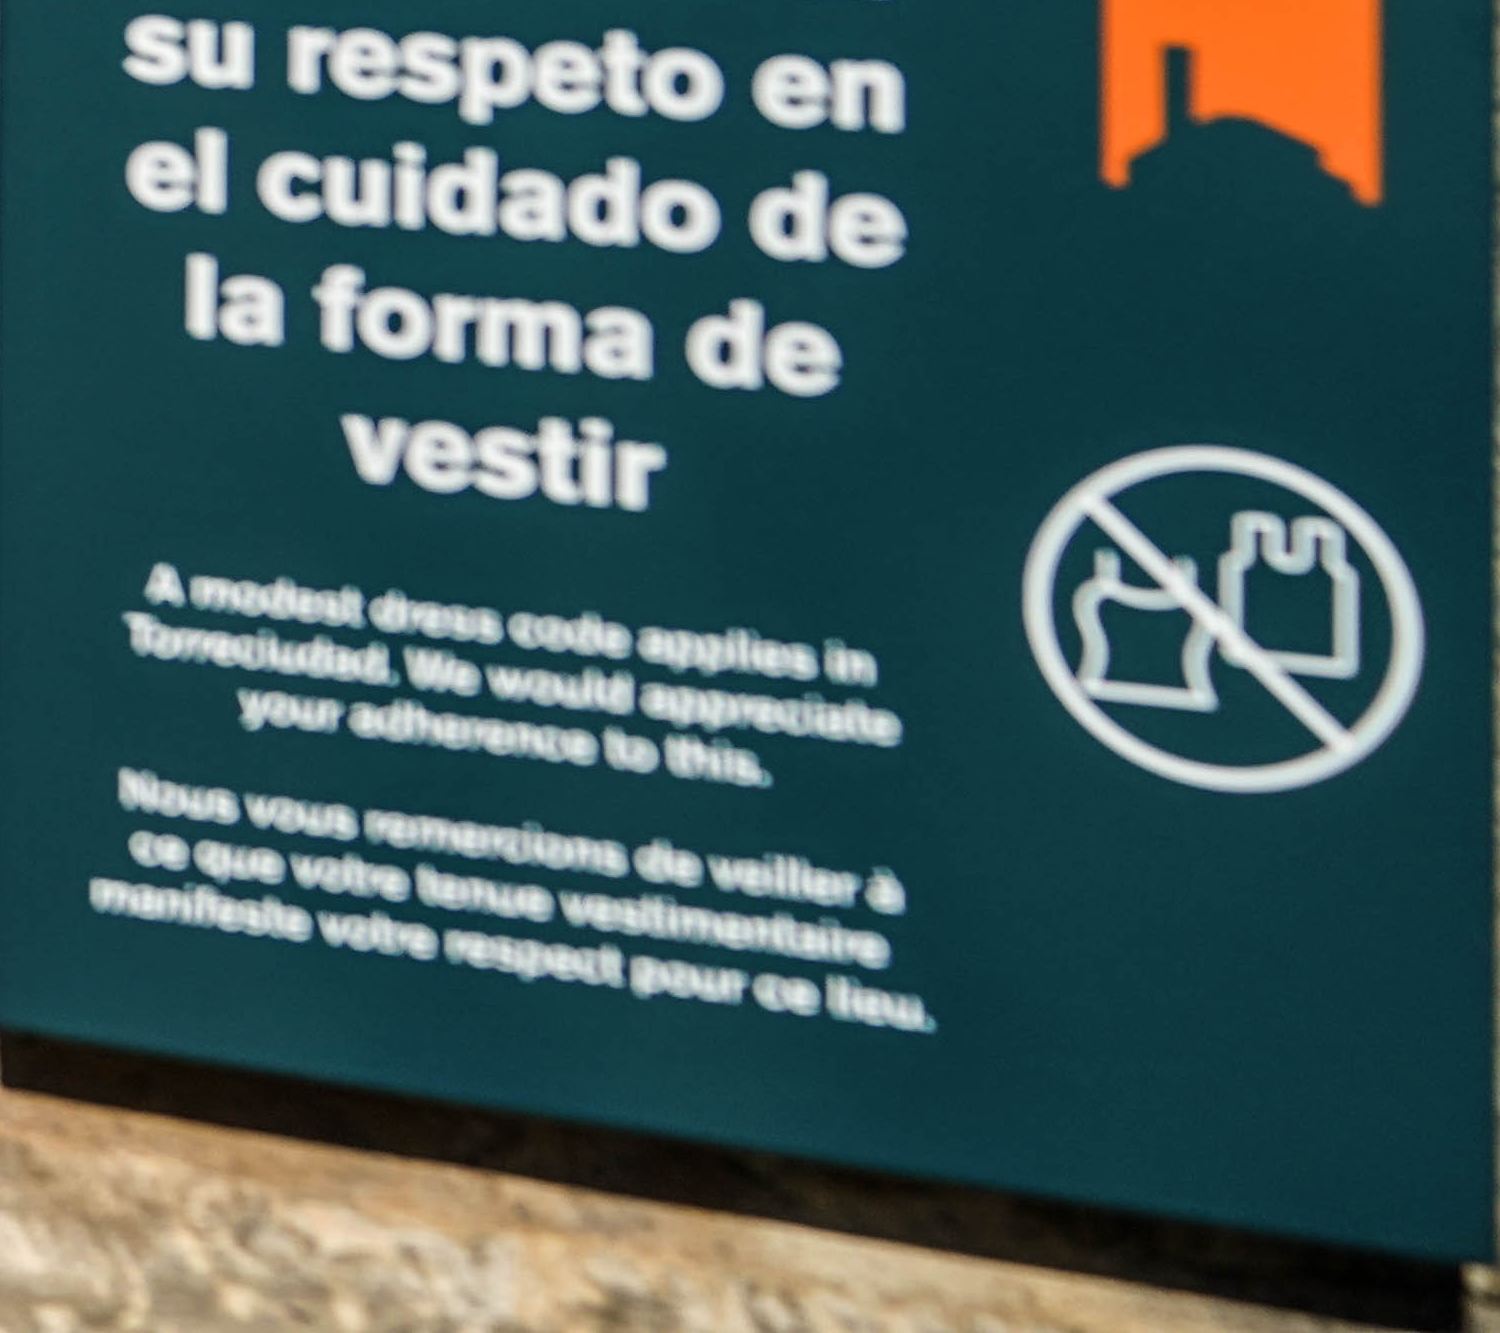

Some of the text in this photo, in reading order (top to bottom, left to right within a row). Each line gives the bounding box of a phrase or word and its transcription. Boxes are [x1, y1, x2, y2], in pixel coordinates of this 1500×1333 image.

[122, 14, 904, 133] su respeto en
[125, 126, 907, 268] el cuidado de
[185, 252, 841, 396] la forma de
[341, 413, 667, 511] vestir
[123, 610, 903, 748] Torreciudad. We would appreciate
[143, 561, 879, 684] A modest dress code applies in
[236, 690, 774, 789] your adherence to this.
[116, 766, 907, 916] Nous vous remercions de veiller à
[127, 829, 891, 970] ce que votre tenue vestimentaire
[87, 876, 937, 1034] manifeste votre respect pour ce lieu.
